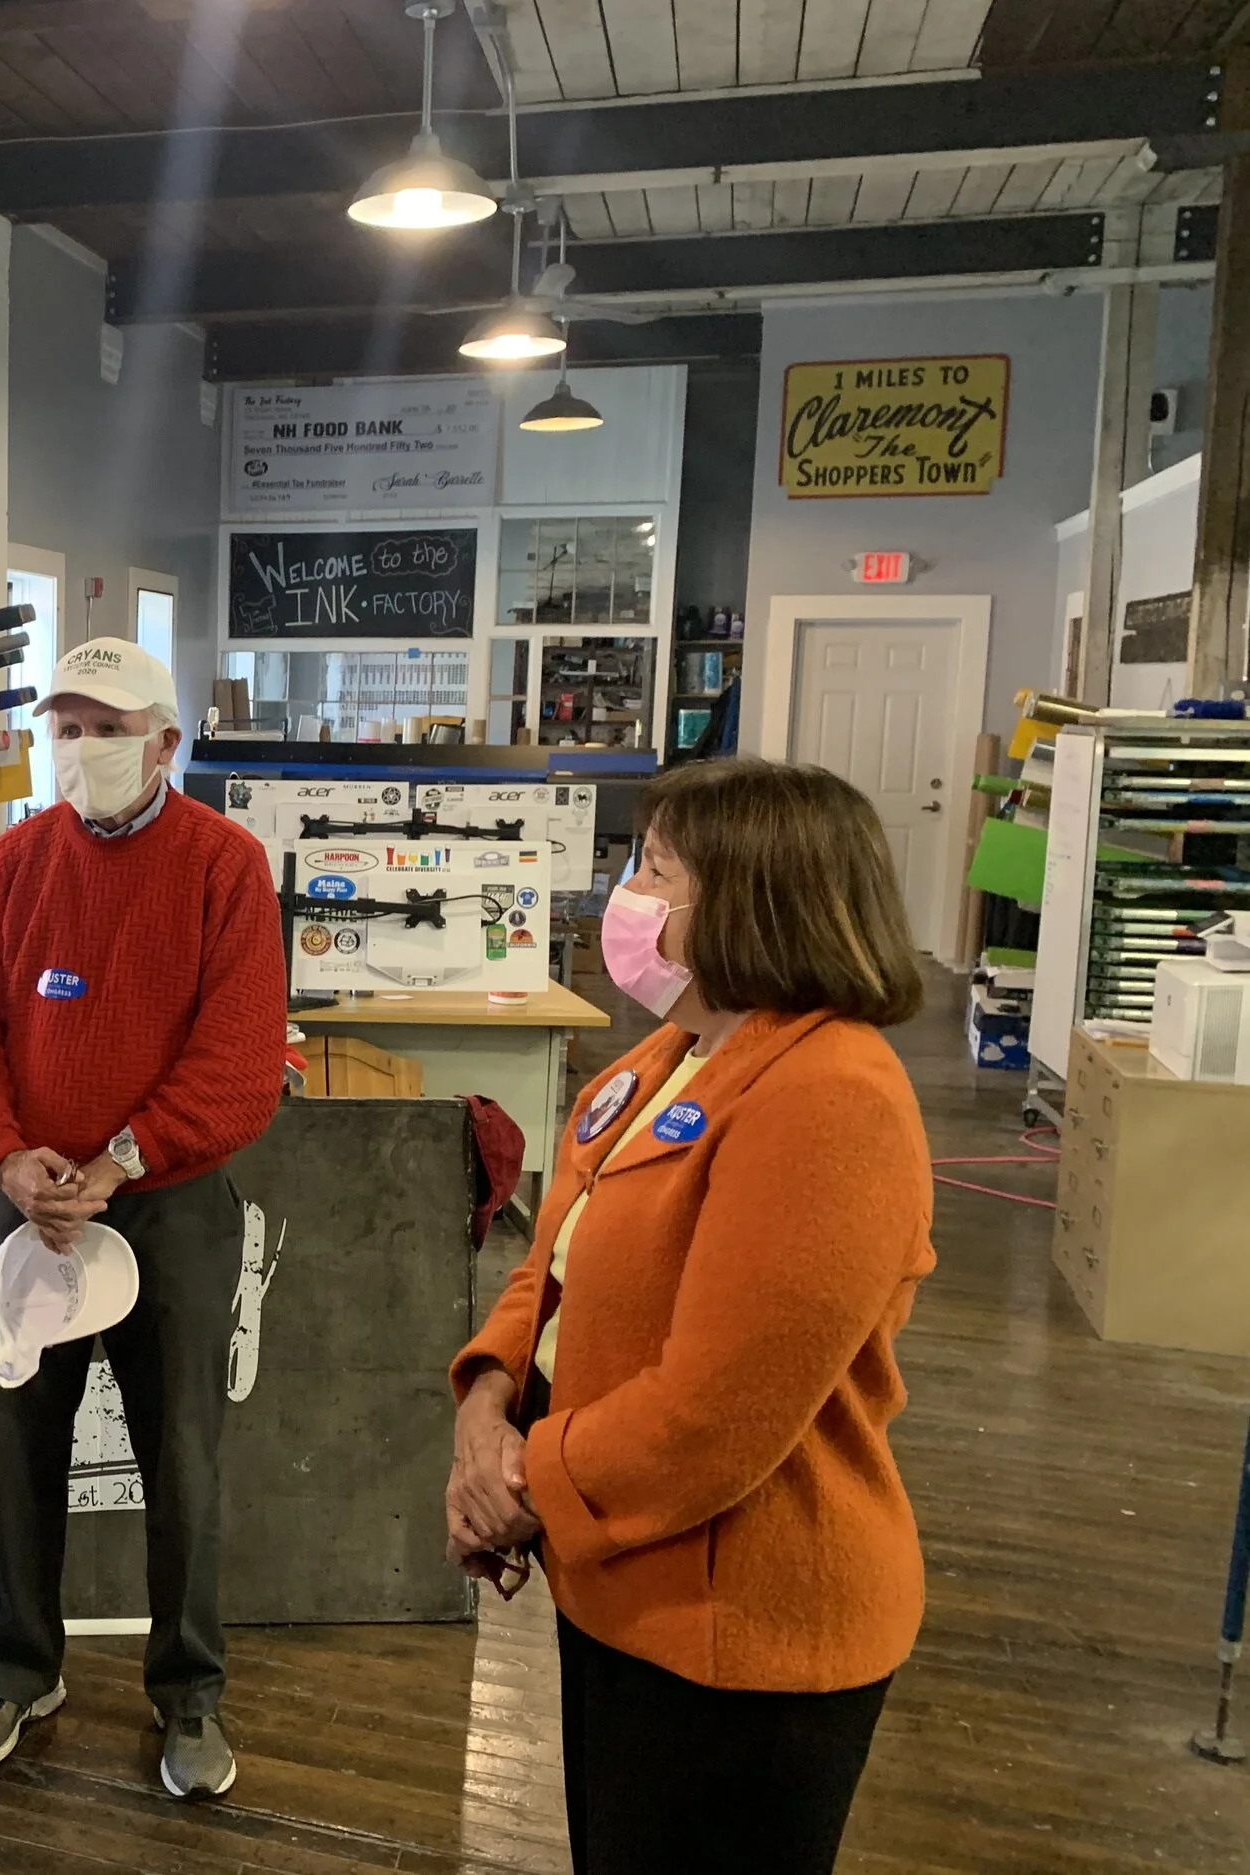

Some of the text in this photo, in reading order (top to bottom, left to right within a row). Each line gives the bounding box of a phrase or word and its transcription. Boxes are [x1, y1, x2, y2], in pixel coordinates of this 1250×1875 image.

[833, 365, 969, 390] 1 MILES TO
[273, 423, 297, 438] NH
[304, 421, 349, 437] FOOD
[355, 420, 403, 436] BANK
[787, 393, 996, 459] Claremont
[244, 444, 272, 455] Seven
[276, 443, 322, 454] Thousand
[324, 443, 344, 453] Five
[346, 442, 388, 452] Hundred
[390, 440, 410, 452] Fifty
[414, 439, 434, 450] Two
[797, 458, 905, 487] SHOPPERS
[249, 541, 448, 593] WELCOME to the
[862, 553, 903, 580] EXIT
[285, 584, 463, 627] INK FACTORY
[67, 649, 122, 664] CRYANS
[297, 787, 335, 798] acer
[489, 791, 526, 801] acer
[324, 852, 360, 862] HARPOON
[317, 879, 346, 888] Maine
[46, 972, 80, 986] USTER
[666, 1104, 702, 1127] KUSTER
